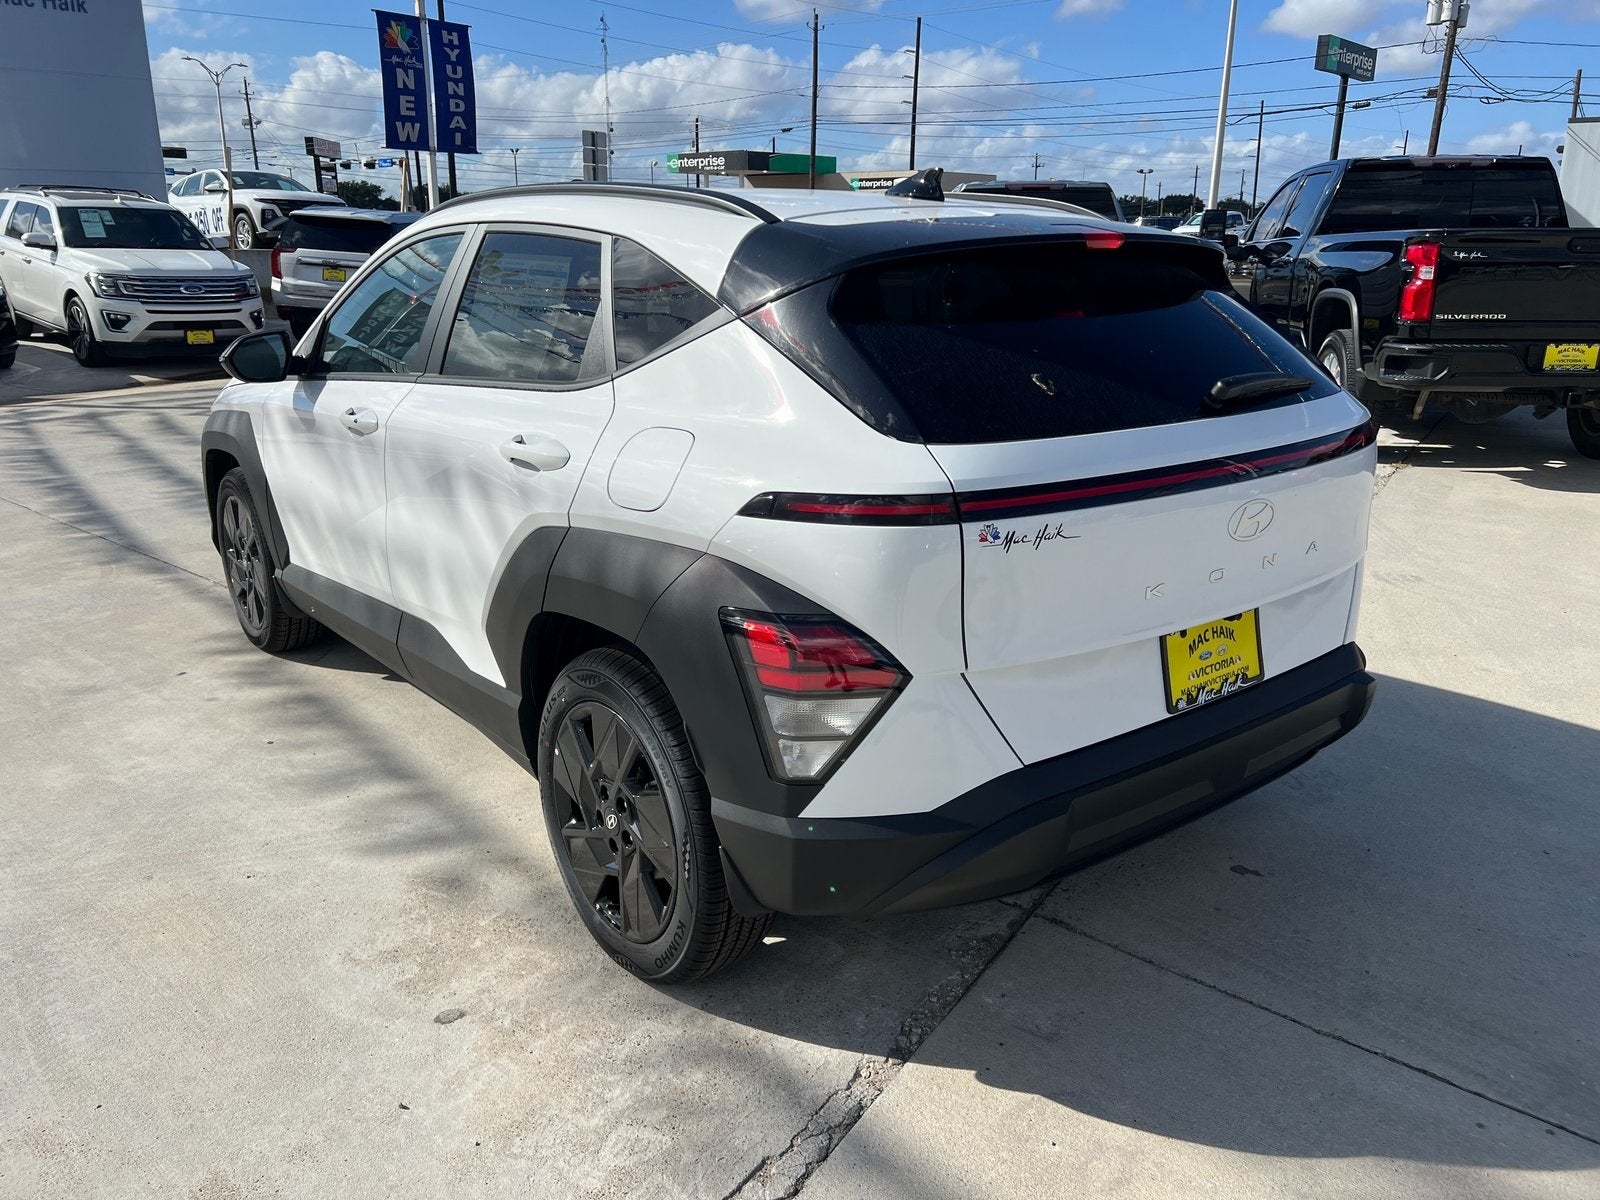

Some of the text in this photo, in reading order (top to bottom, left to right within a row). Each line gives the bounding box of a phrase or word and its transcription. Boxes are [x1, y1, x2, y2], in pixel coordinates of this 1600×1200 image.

[1330, 46, 1373, 70] enterprise
[441, 30, 467, 145] HYUNDAI
[395, 68, 420, 142] NEW
[669, 155, 725, 169] enterprise
[851, 180, 892, 189] enterprise
[212, 207, 224, 232] OFF
[1557, 347, 1586, 355] MAC HAIK
[999, 523, 1081, 554] Mac Haik
[1144, 540, 1319, 601] KONA
[1188, 625, 1236, 658] MAC HAIK
[1194, 656, 1235, 680] VICTORIA
[1197, 675, 1258, 705] Mac Haik
[654, 920, 686, 969] KUMHO
